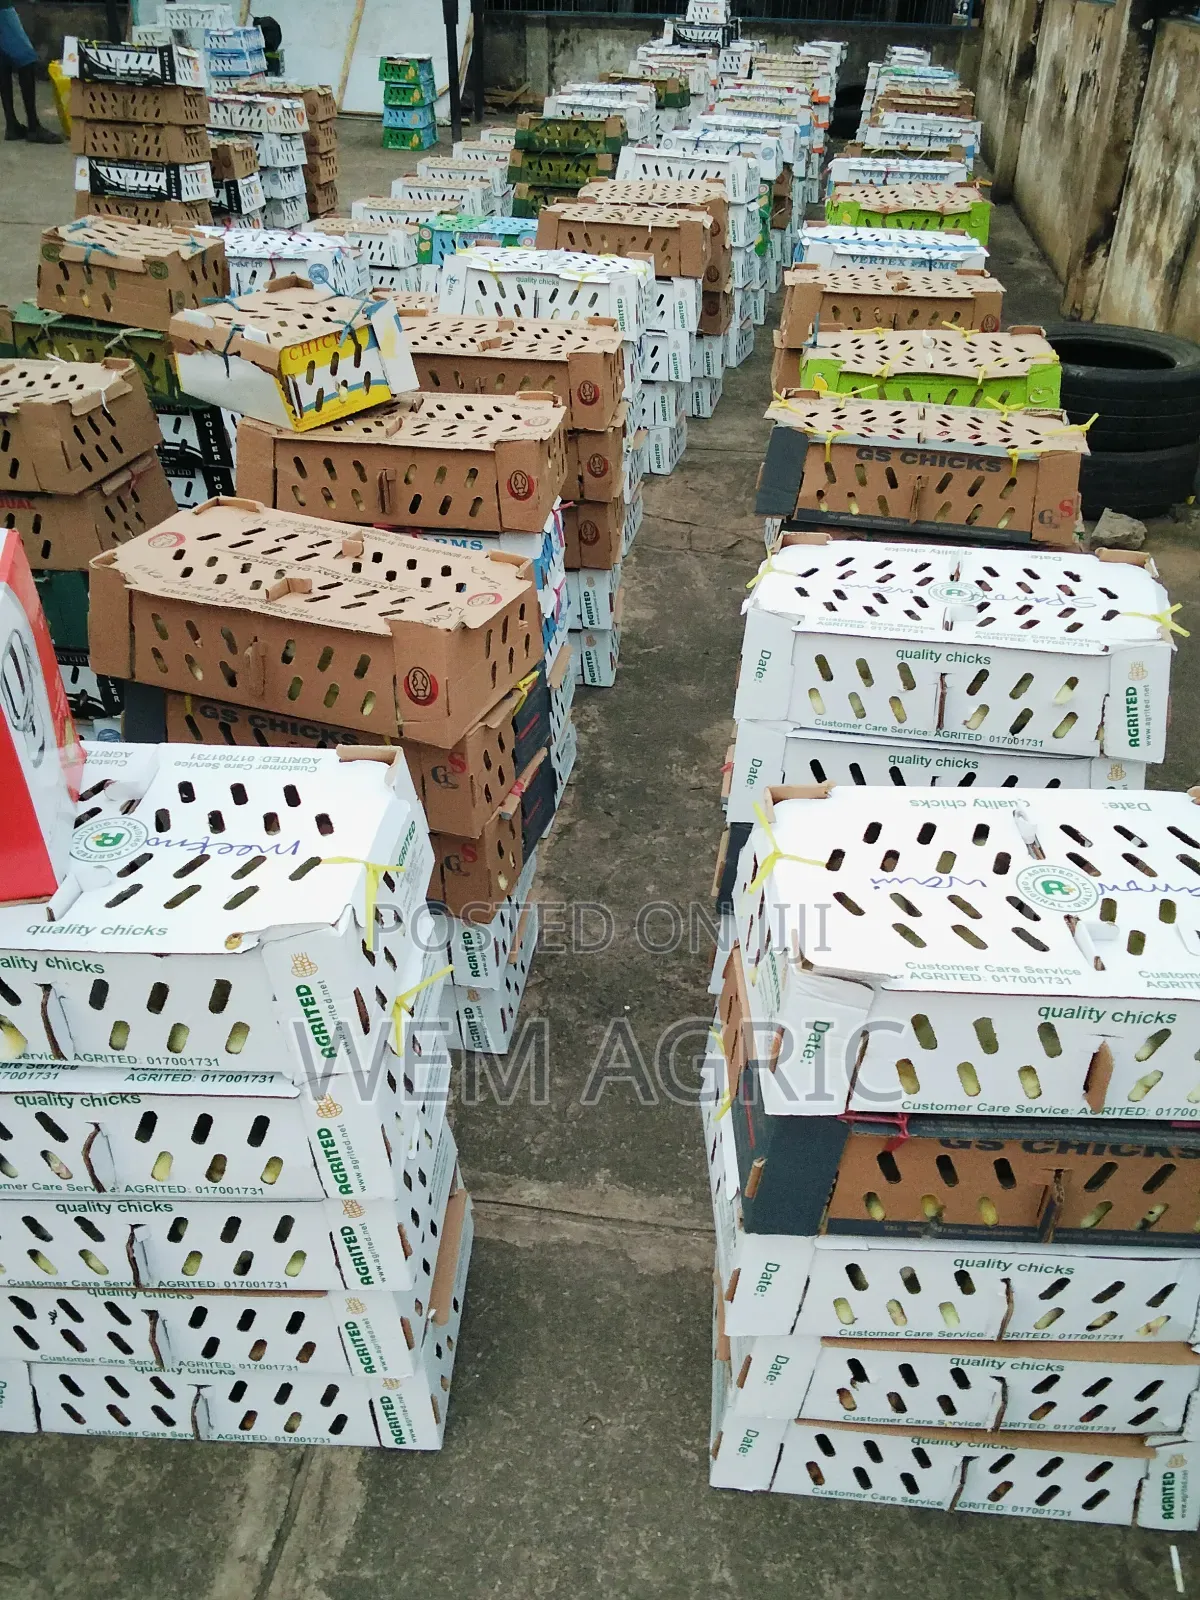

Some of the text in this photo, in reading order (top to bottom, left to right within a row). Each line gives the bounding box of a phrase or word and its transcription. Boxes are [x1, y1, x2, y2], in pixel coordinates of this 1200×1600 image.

[850, 255, 906, 267] VERTEX
[515, 275, 560, 287] quality chicks
[203, 412, 221, 462] NOILER
[855, 447, 1002, 473] GS CHICKS
[232, 554, 274, 567] CHICKS
[584, 591, 596, 627] AGRITED
[584, 650, 597, 684] AGRITED
[753, 649, 772, 683] Date:
[895, 649, 992, 666] quality chicks
[199, 703, 360, 746] GS CHICKS
[1125, 686, 1141, 748] AGRITED
[814, 718, 1044, 748] Customer Care Service: AGRITED: 017001731
[174, 760, 318, 773] Customer Care Service
[190, 752, 322, 765] AGRITED: 017001731
[888, 754, 979, 770] quality chicks
[744, 757, 763, 790] Date:
[908, 798, 967, 810] chicks
[1102, 801, 1152, 812] Date:
[1025, 866, 1074, 878] AGRITED
[1041, 879, 1070, 896] R
[26, 923, 169, 937] quality chicks
[462, 930, 481, 979] AGRITED
[0, 957, 105, 975] ality chicks
[904, 961, 1082, 977] Customer Care Service
[1137, 970, 1200, 980] Custom
[909, 971, 1073, 986] AGRITED: 017001731
[295, 984, 338, 1060] AGRITED
[317, 979, 352, 1056] www.agrited.net
[1037, 1004, 1178, 1025] quality chicks
[464, 1006, 483, 1050] AGRITED
[799, 1019, 831, 1065] Date:
[73, 1053, 220, 1068] AGRITED: 017001731
[124, 1073, 275, 1084] AGRITED: 017001731
[14, 1093, 142, 1109] quality chicks
[901, 1100, 1074, 1116] Customer Care Service:
[317, 1127, 354, 1195] AGRITED
[336, 1123, 367, 1192] www.agrited.net
[32, 1182, 64, 1191] Care
[124, 1184, 192, 1195] AGRITED:
[195, 1185, 265, 1196] 017001731
[55, 1201, 174, 1215] quality chicks
[340, 1224, 375, 1286] AGRITED
[358, 1222, 386, 1284] www.agrited.net
[953, 1256, 1076, 1276] quality chicks
[7, 1278, 289, 1290] Customer Care AGRITED: 017001731
[752, 1261, 781, 1297] Date:
[362, 1317, 389, 1372] www.agrited.net
[838, 1328, 1124, 1342] Customer Care Service: GRITED: 017001731
[344, 1320, 377, 1375] AGRITED
[40, 1354, 299, 1373] Customer Care AGRITED: 017001731
[763, 1354, 790, 1386] Date:
[950, 1356, 1065, 1373] quality chicks
[379, 1395, 407, 1446] AGRITED
[843, 1413, 1117, 1433] Customer Care GRITED: 017001731
[86, 1427, 332, 1445] Customer Care AGRITED: 017001731
[735, 1428, 760, 1457] Date:
[811, 1486, 865, 1498] Customer
[868, 1491, 897, 1503] Care
[1011, 1505, 1072, 1518] 017001731
[1162, 1470, 1176, 1520] AGRITED
